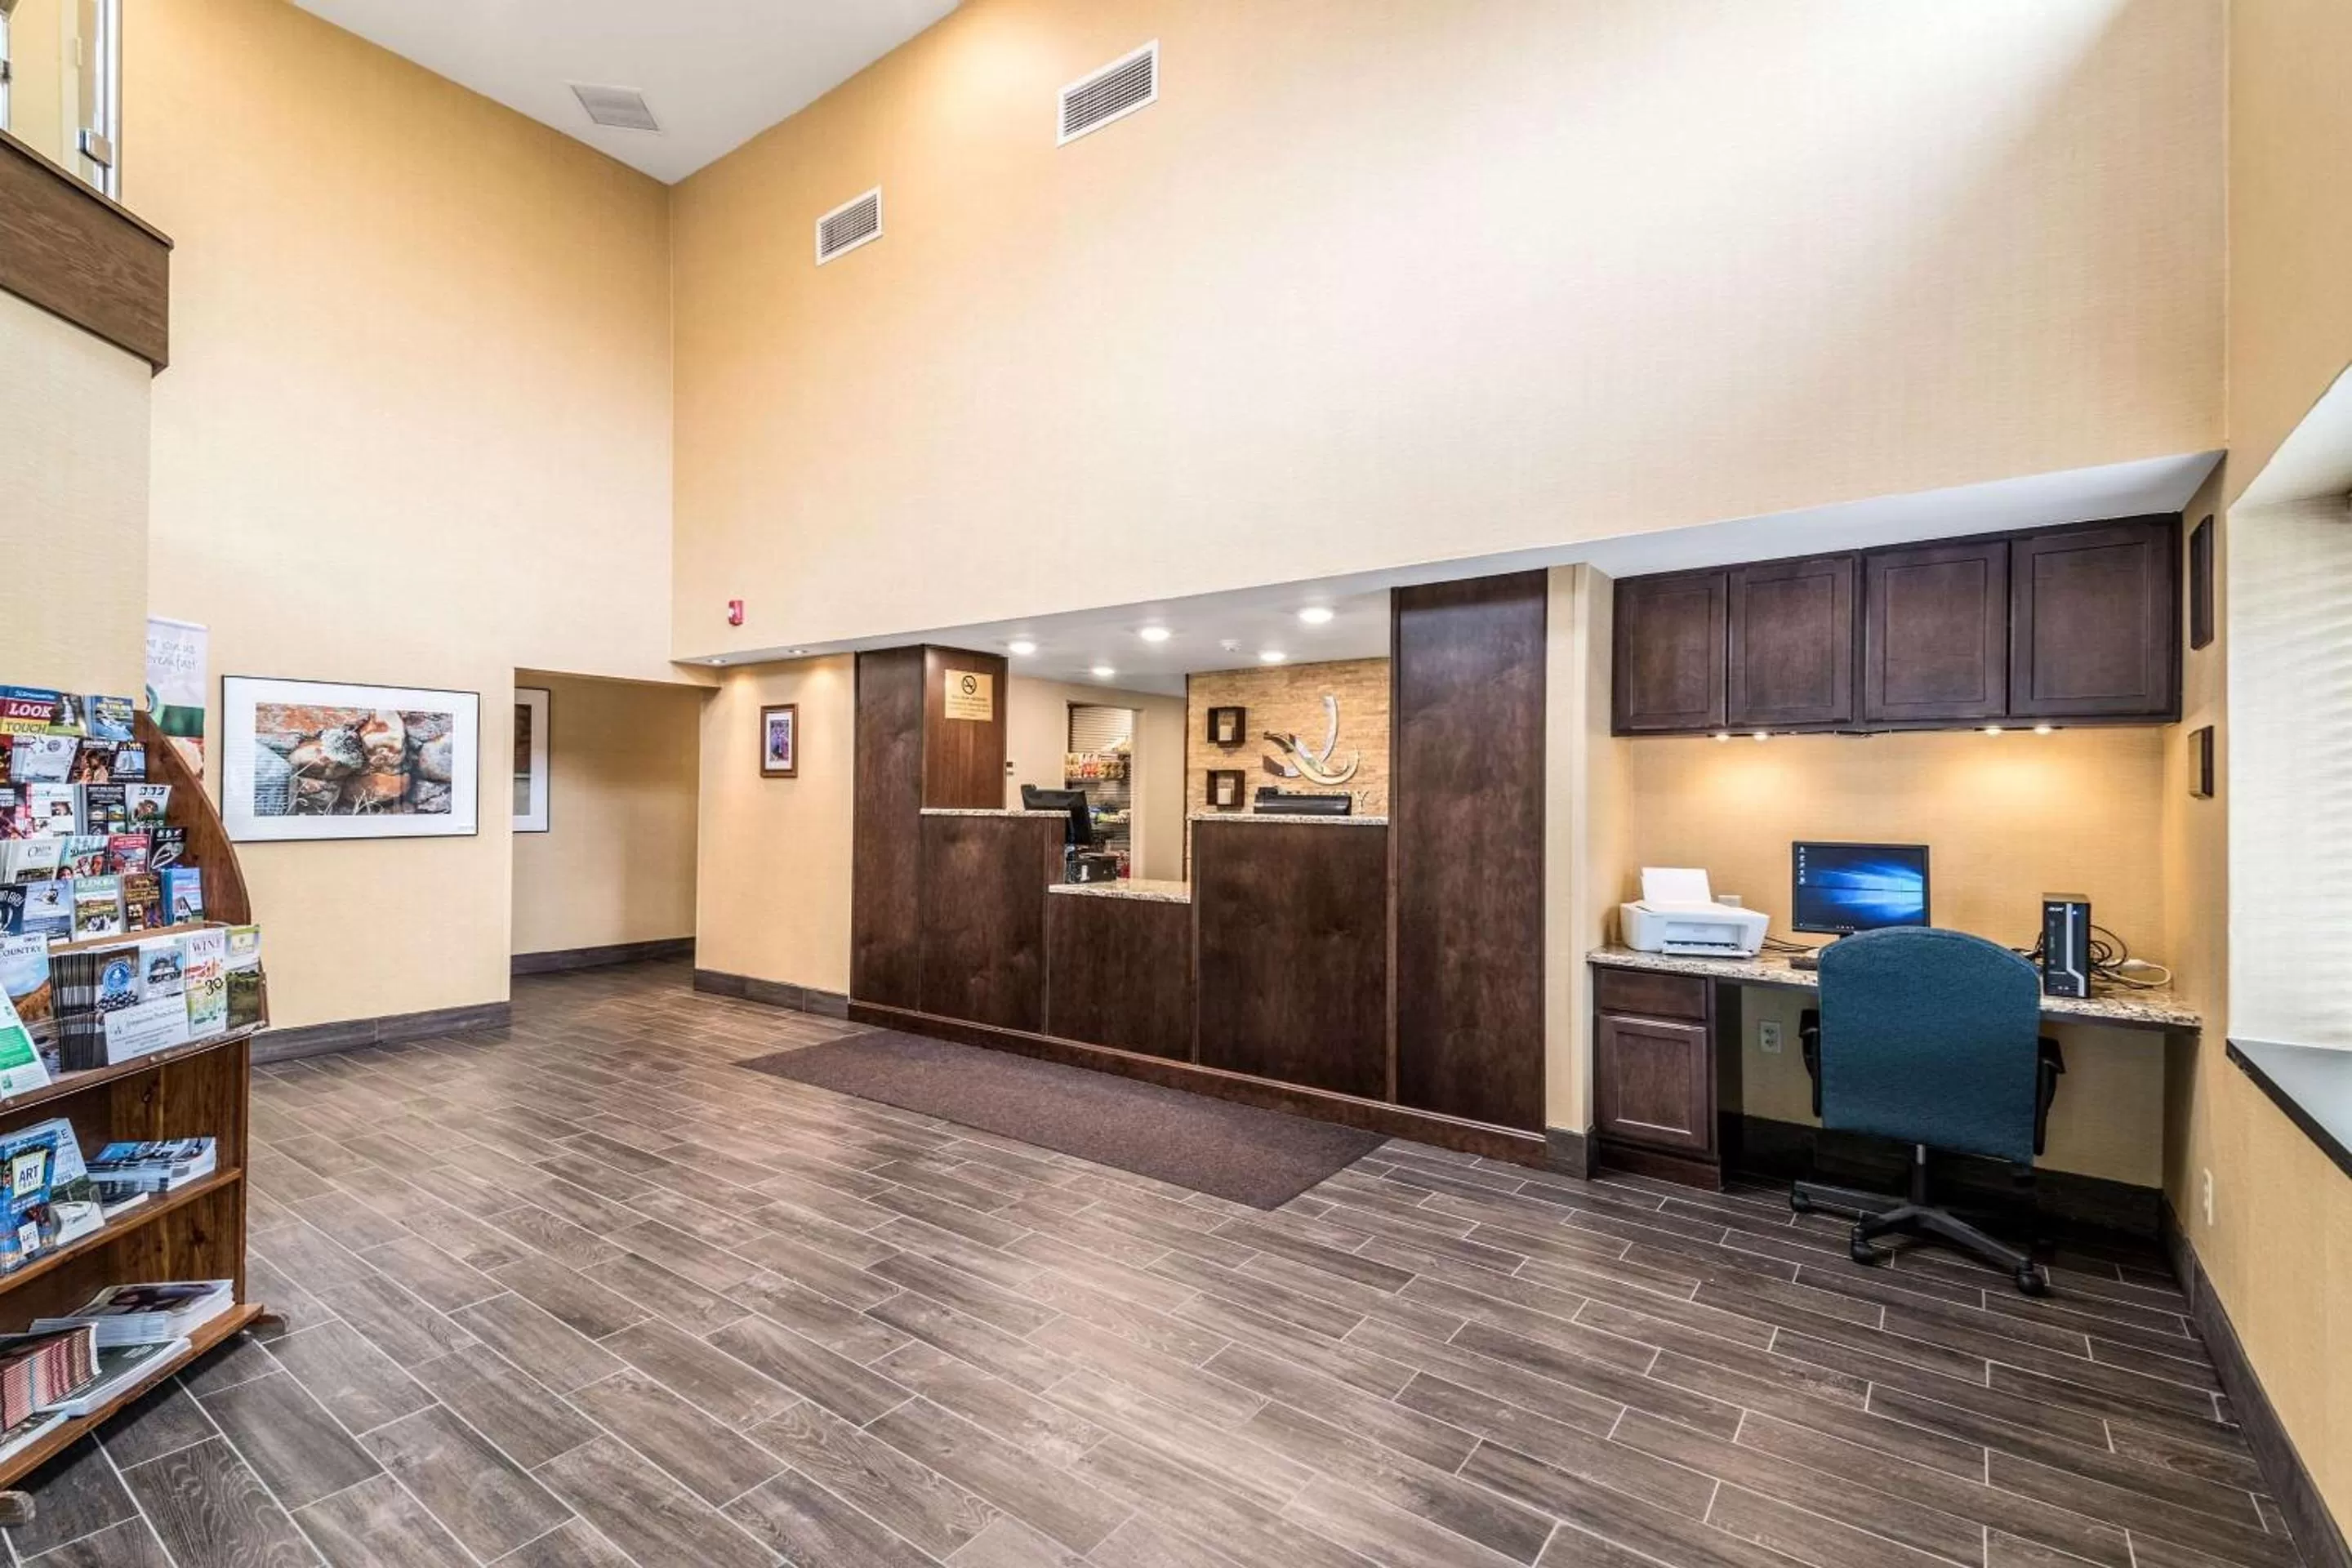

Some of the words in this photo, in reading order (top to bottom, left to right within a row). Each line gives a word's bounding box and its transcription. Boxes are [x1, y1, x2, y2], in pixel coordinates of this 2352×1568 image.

[9, 702, 53, 718] LOOK
[6, 722, 47, 733] TOUCH
[2, 946, 41, 956] OUNTRY
[205, 977, 223, 996] 30
[19, 1165, 40, 1182] ART
